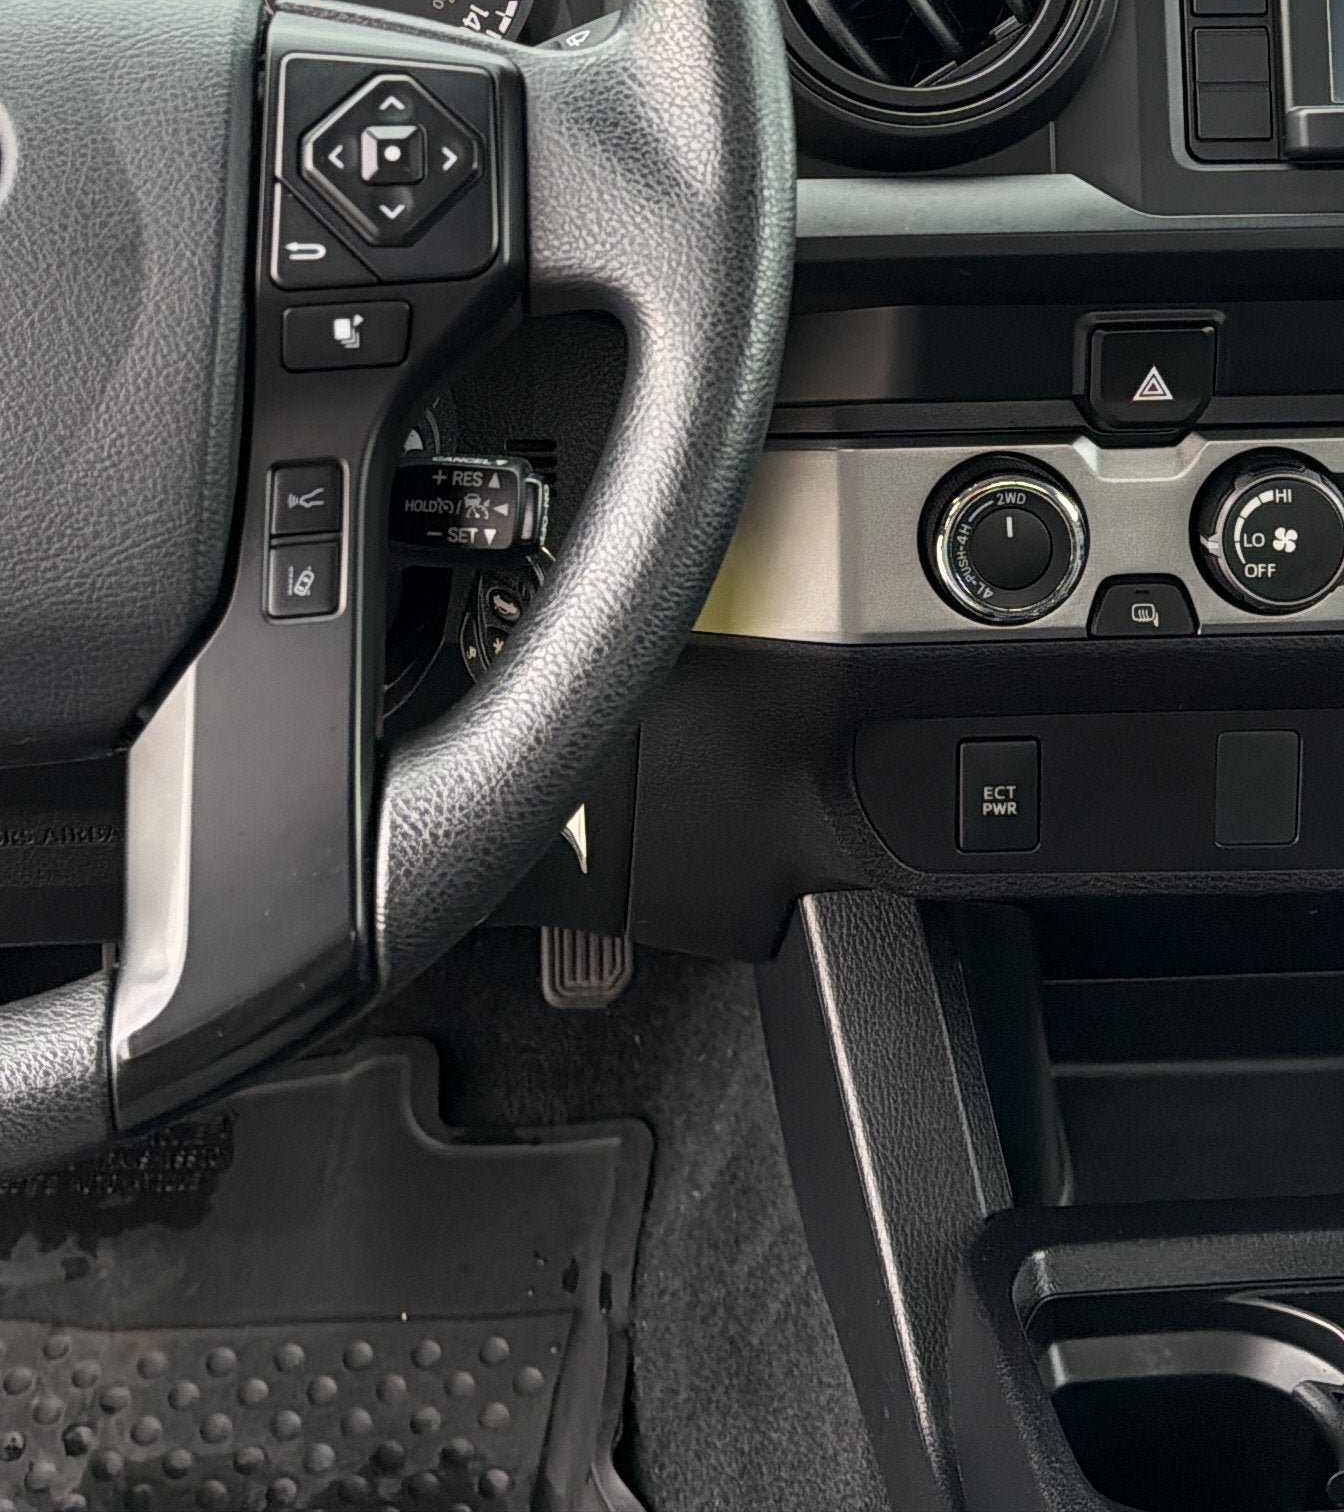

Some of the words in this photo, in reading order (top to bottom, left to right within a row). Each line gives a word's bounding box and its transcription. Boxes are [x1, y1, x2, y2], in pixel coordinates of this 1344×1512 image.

[462, 3, 490, 32] 14
[452, 470, 484, 488] RES
[995, 491, 1027, 506] 2WD
[1274, 488, 1293, 504] HI
[405, 498, 438, 514] HOLD
[447, 527, 479, 545] SET
[1242, 533, 1266, 548] LO
[1243, 562, 1277, 578] OFF
[983, 786, 1016, 800] ECT
[982, 801, 1018, 816] PWR
